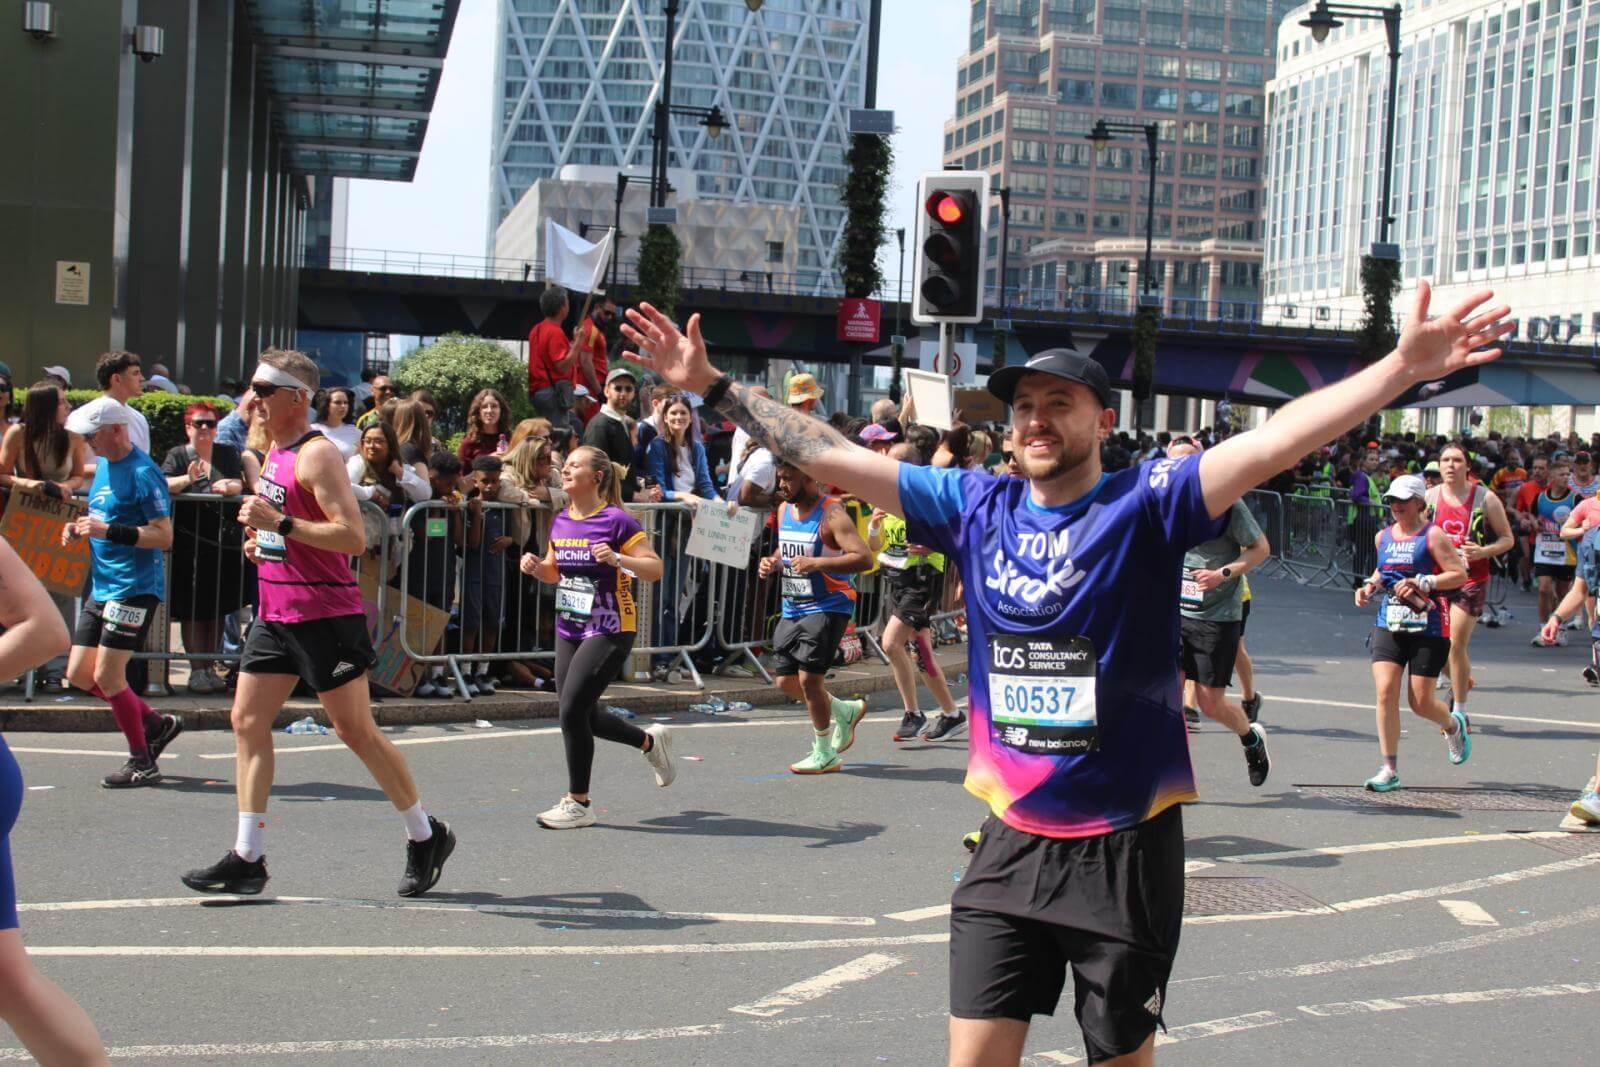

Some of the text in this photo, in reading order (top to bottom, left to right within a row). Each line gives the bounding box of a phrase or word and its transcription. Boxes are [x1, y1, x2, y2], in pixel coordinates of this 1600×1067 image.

[1017, 528, 1069, 559] TOM
[1385, 541, 1416, 553] JAMIE
[556, 549, 590, 560] ellChild
[985, 548, 1087, 603] Stroke
[109, 606, 140, 624] 67705
[997, 600, 1063, 617] Association
[1028, 642, 1053, 651] TATA
[993, 640, 1026, 669] tcs
[1028, 651, 1088, 661] CONSULTANCY
[1028, 661, 1066, 670] SERVICES
[1004, 684, 1076, 715] 60537
[1028, 737, 1088, 748] new balance
